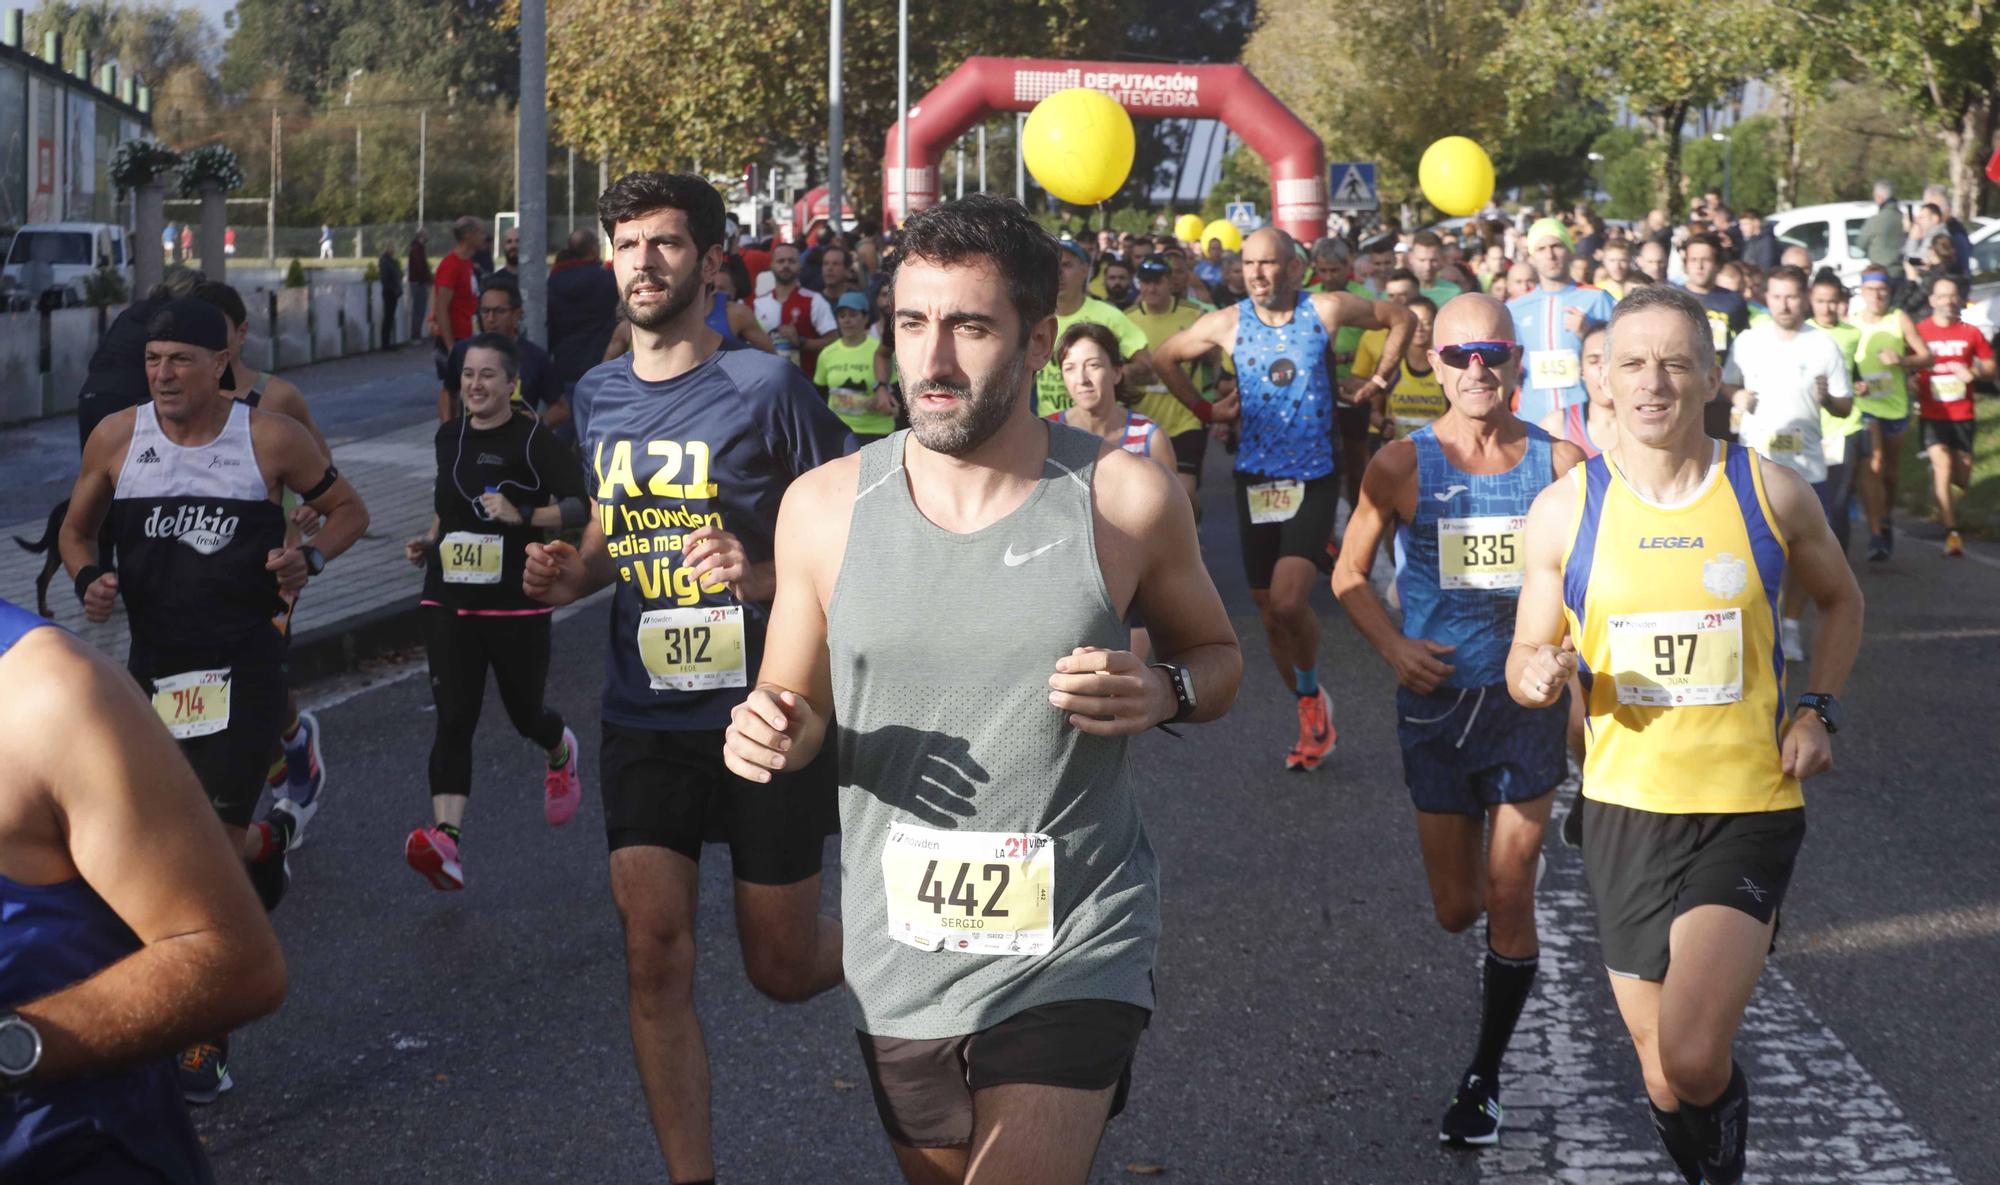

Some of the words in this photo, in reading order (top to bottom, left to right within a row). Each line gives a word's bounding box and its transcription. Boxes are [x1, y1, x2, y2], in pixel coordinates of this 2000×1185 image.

[1084, 72, 1199, 90] DEPUTACIÓN
[1103, 89, 1199, 107] NTEVEDRA
[648, 440, 719, 500] 21
[1260, 489, 1291, 509] 724
[144, 504, 240, 539] delikia
[620, 504, 724, 532] howden
[196, 535, 220, 546] fresh
[1463, 533, 1515, 567] 335
[1639, 536, 1704, 549] LEGEA
[453, 543, 483, 567] 341
[711, 610, 727, 622] 21
[1697, 622, 1705, 630] LA
[1704, 613, 1723, 629] 21
[665, 626, 712, 665] 312
[1654, 634, 1698, 676] 97
[172, 686, 205, 719] 714
[995, 848, 1006, 859] LA
[1005, 837, 1028, 858] 21
[917, 859, 1010, 918] 442
[941, 917, 985, 929] SERGIO
